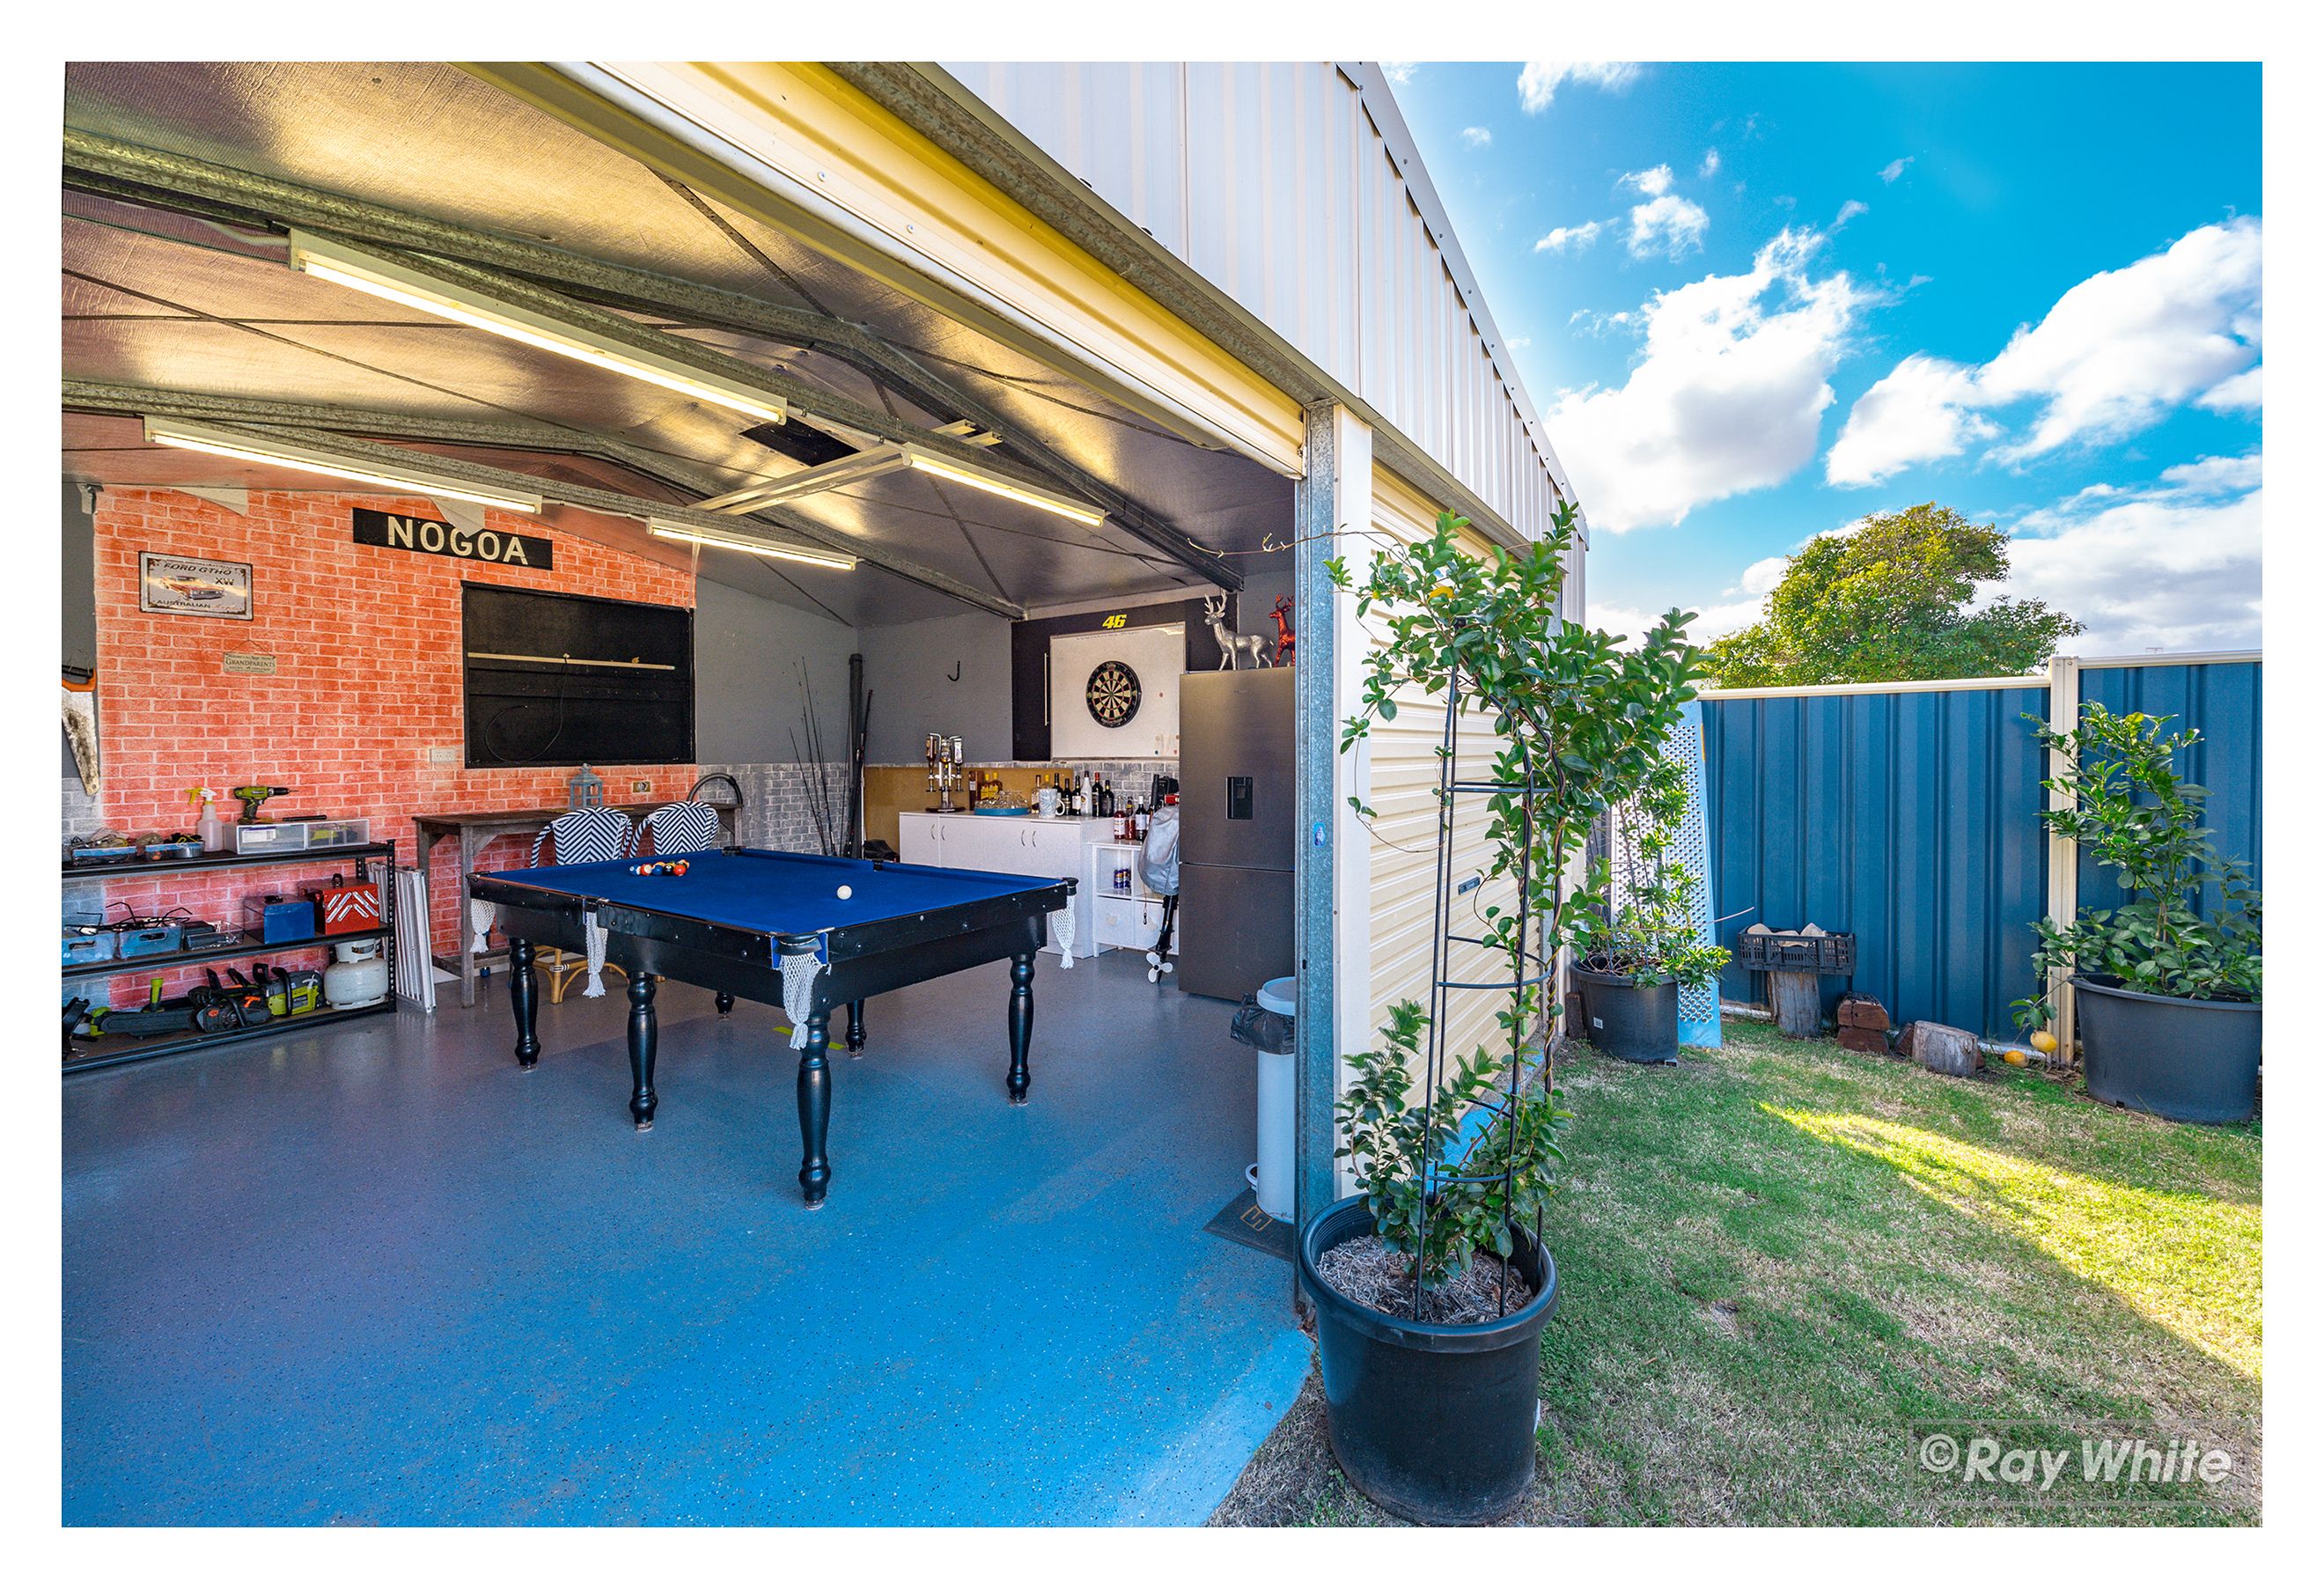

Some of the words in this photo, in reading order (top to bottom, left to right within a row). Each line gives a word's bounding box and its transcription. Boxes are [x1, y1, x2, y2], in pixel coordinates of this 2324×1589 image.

[387, 516, 528, 565] NOGOA
[164, 563, 196, 572] FORD
[198, 566, 232, 576] GTHO
[215, 577, 234, 586] XW
[157, 600, 211, 608] AUSTRALIAN
[1101, 614, 1128, 629] 46
